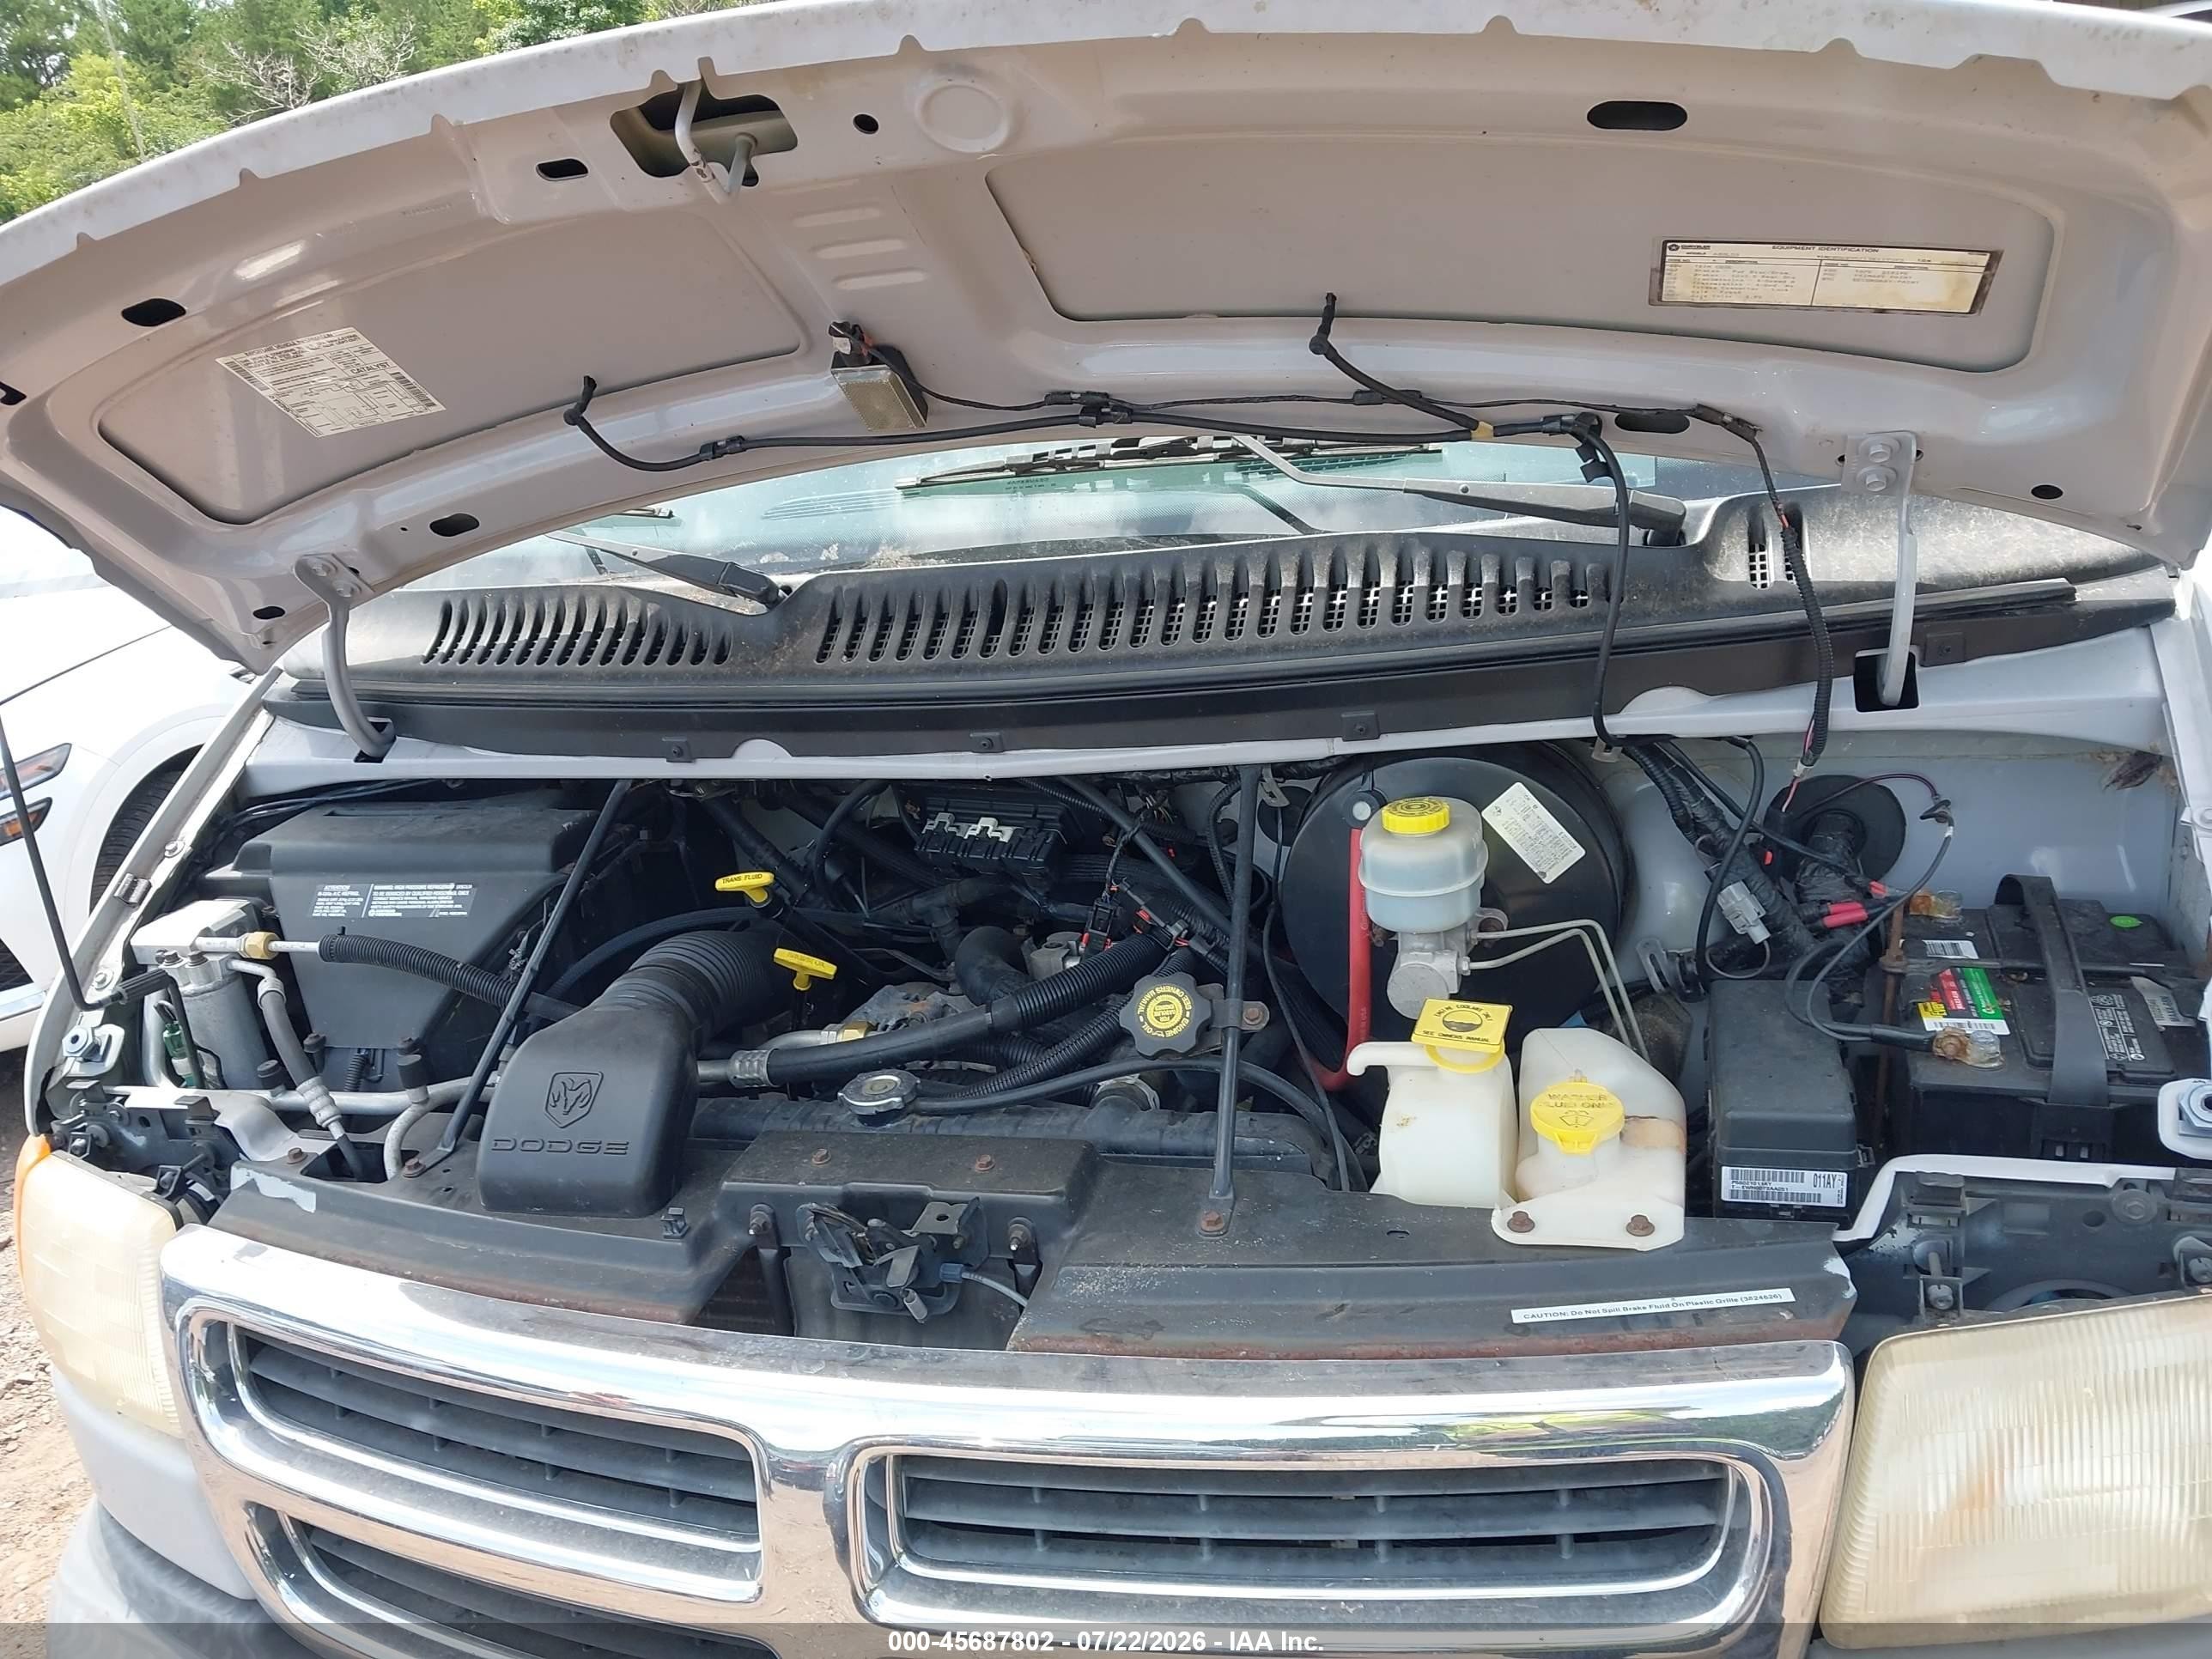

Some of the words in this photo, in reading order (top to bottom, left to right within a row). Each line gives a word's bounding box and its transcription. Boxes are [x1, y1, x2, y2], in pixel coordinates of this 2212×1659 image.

[350, 362, 390, 374] CATALYST
[722, 875, 742, 884] TRANS
[1155, 985, 1185, 998] OWNERS
[1137, 989, 1156, 1014] MANUAL
[1182, 994, 1192, 1010] SEE
[1455, 1004, 1484, 1012] COOLANT
[1141, 1022, 1153, 1034] OIL
[1164, 1017, 1189, 1037] ENGINE
[491, 1138, 629, 1156] DODGE
[1813, 1173, 1838, 1189] 011AY
[1523, 1310, 1570, 1320] CAUTION:
